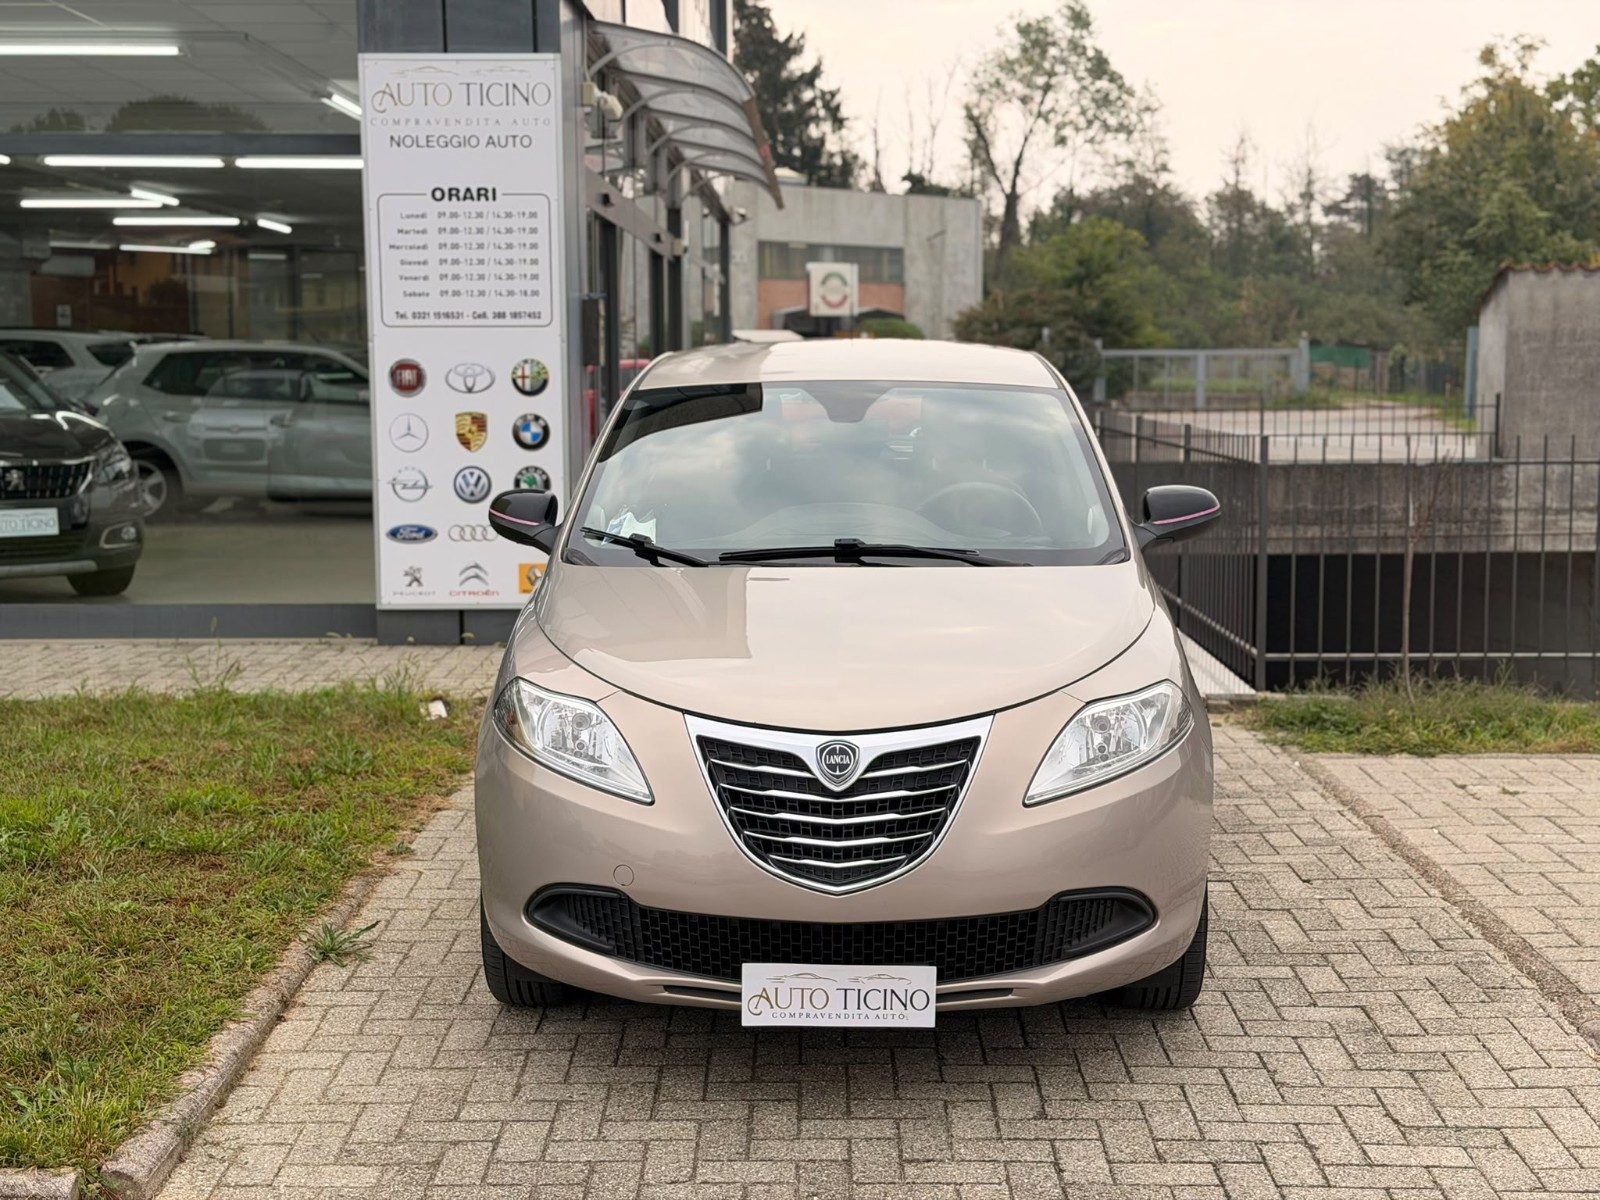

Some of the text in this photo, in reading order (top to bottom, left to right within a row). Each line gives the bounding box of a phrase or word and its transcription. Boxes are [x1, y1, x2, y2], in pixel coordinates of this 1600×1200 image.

[371, 83, 551, 113] AUTO TICINO
[370, 118, 551, 127] COMPRAVENDITA AUTO
[390, 135, 532, 149] NOLEGGIO AUTO
[431, 187, 497, 202] ORARI
[826, 755, 850, 765] LANCIA
[748, 987, 930, 1016] AUTO TICINO
[772, 1012, 870, 1020] COMPRAVENDITA
